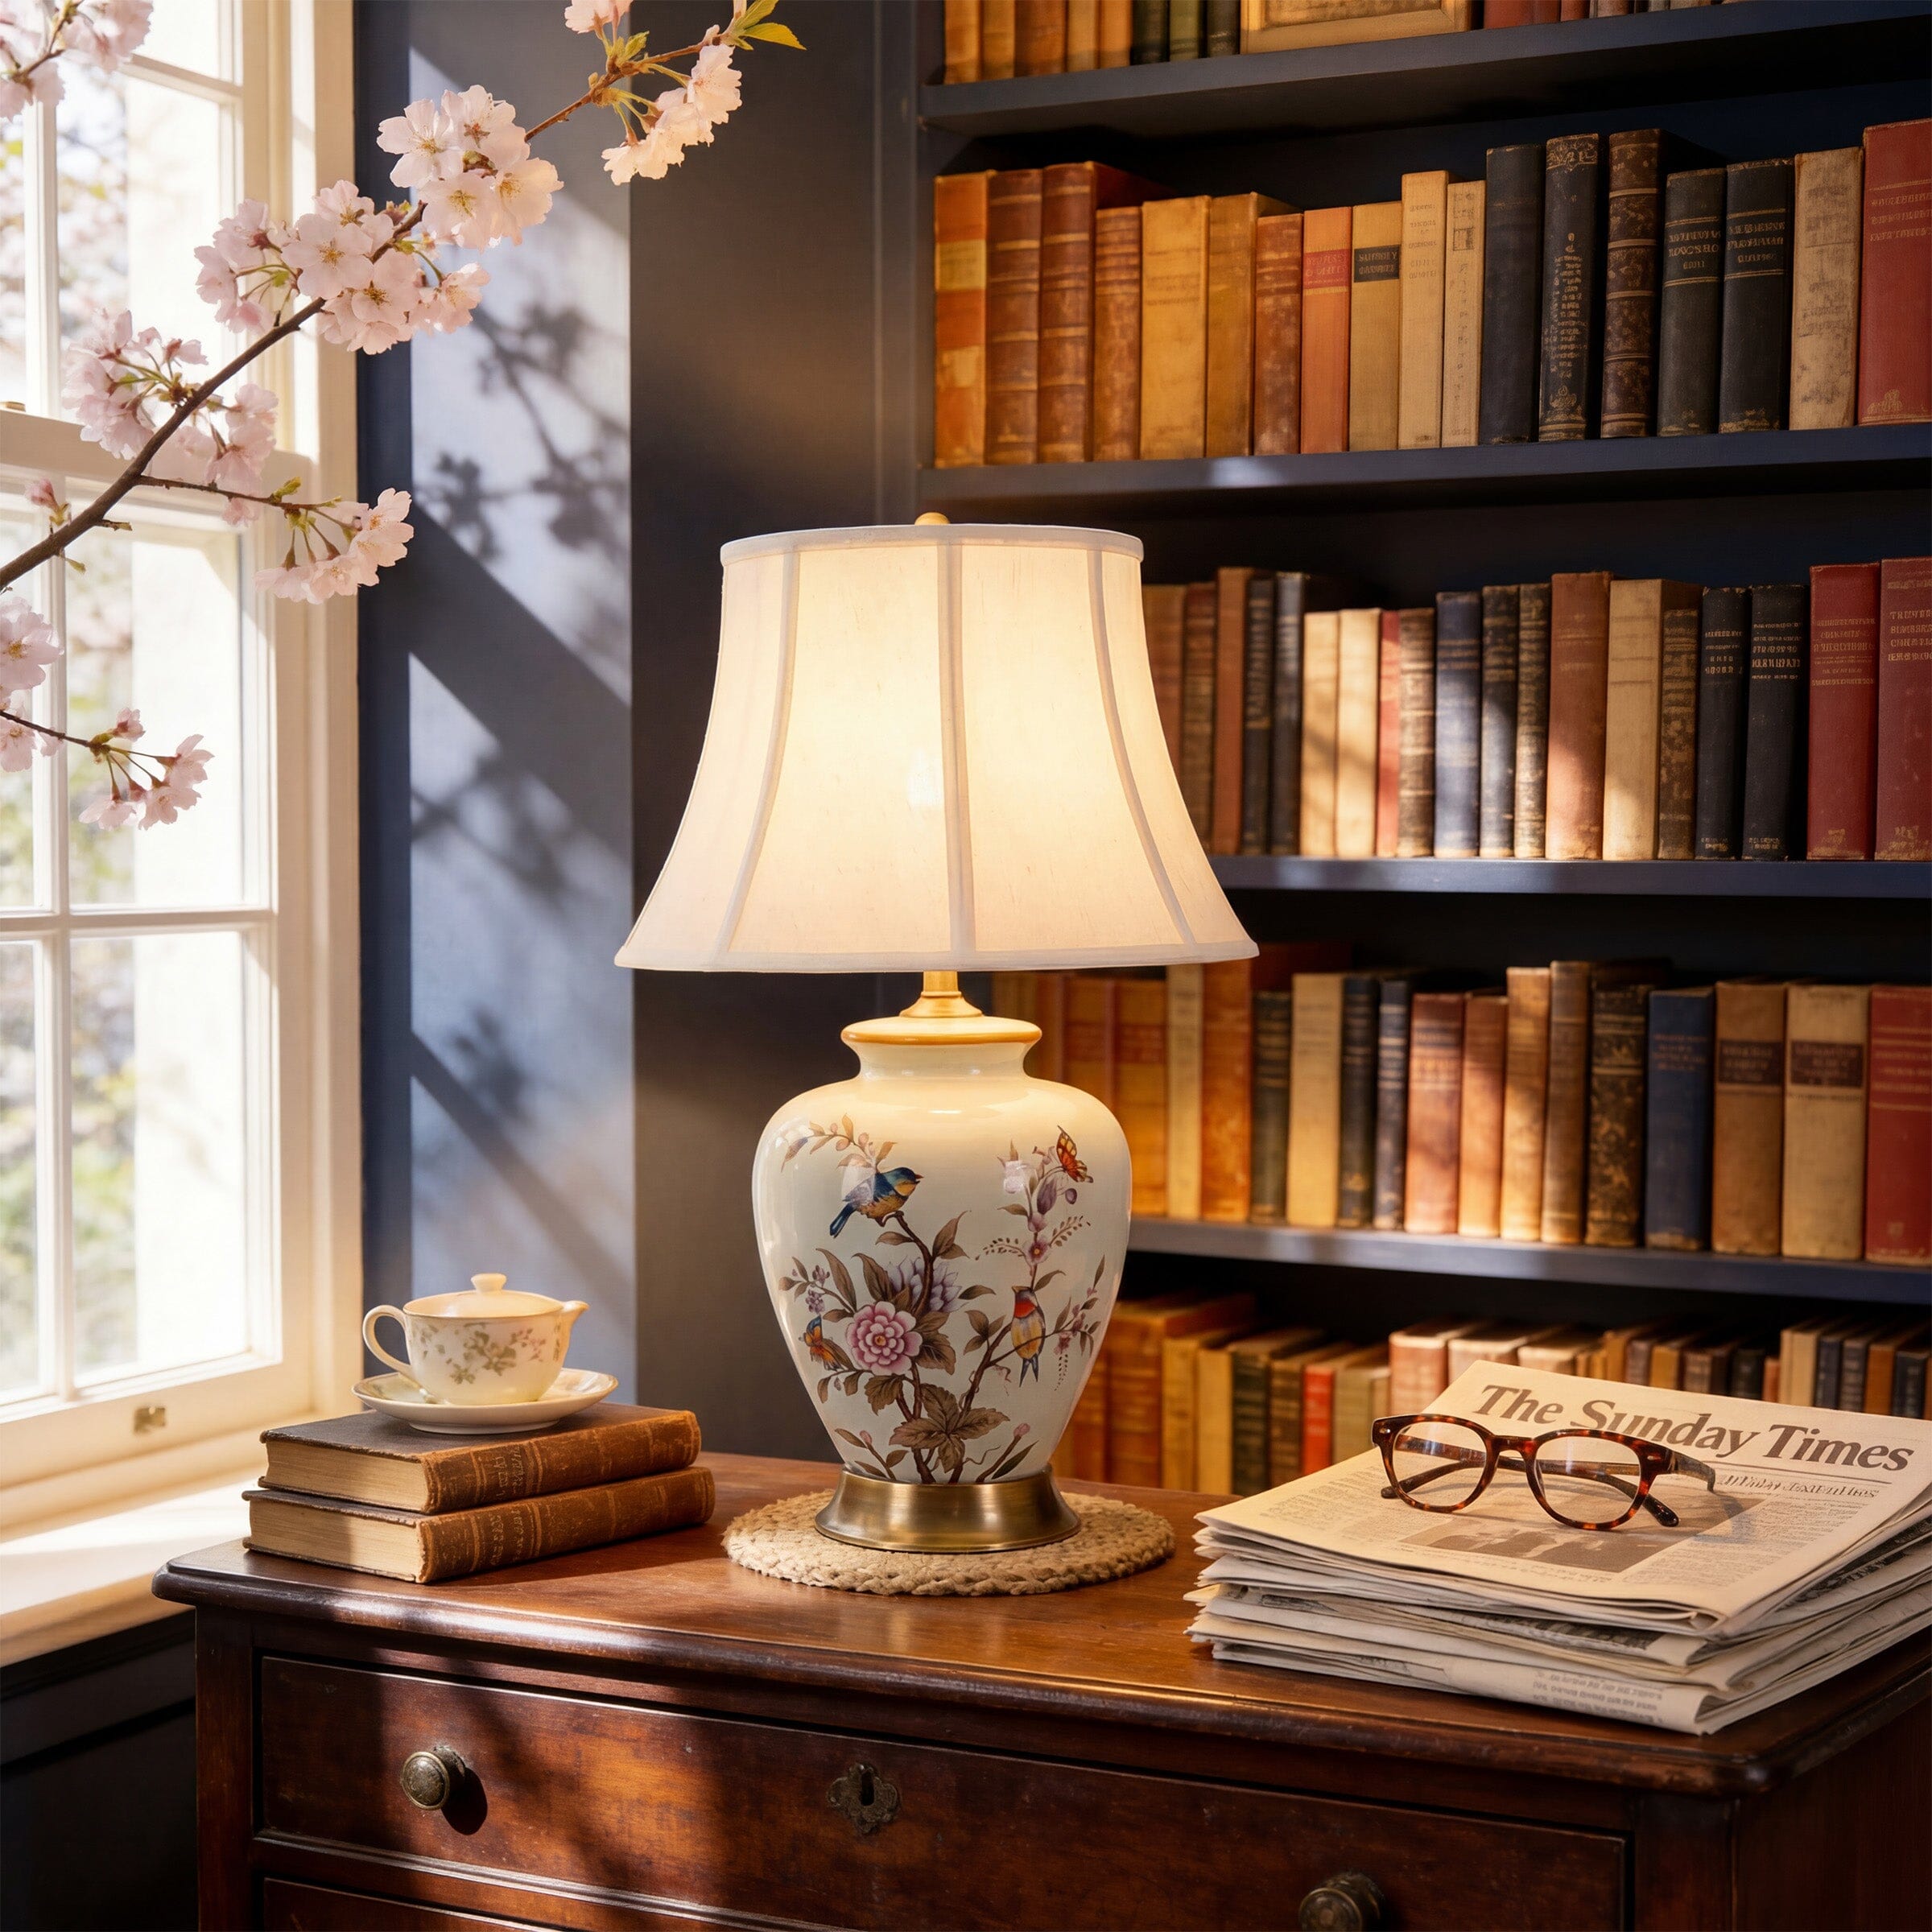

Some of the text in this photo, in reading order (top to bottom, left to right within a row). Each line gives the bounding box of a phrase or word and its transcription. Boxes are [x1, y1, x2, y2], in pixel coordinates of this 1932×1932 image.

[1472, 1385, 1914, 1471] The Sunday Times
